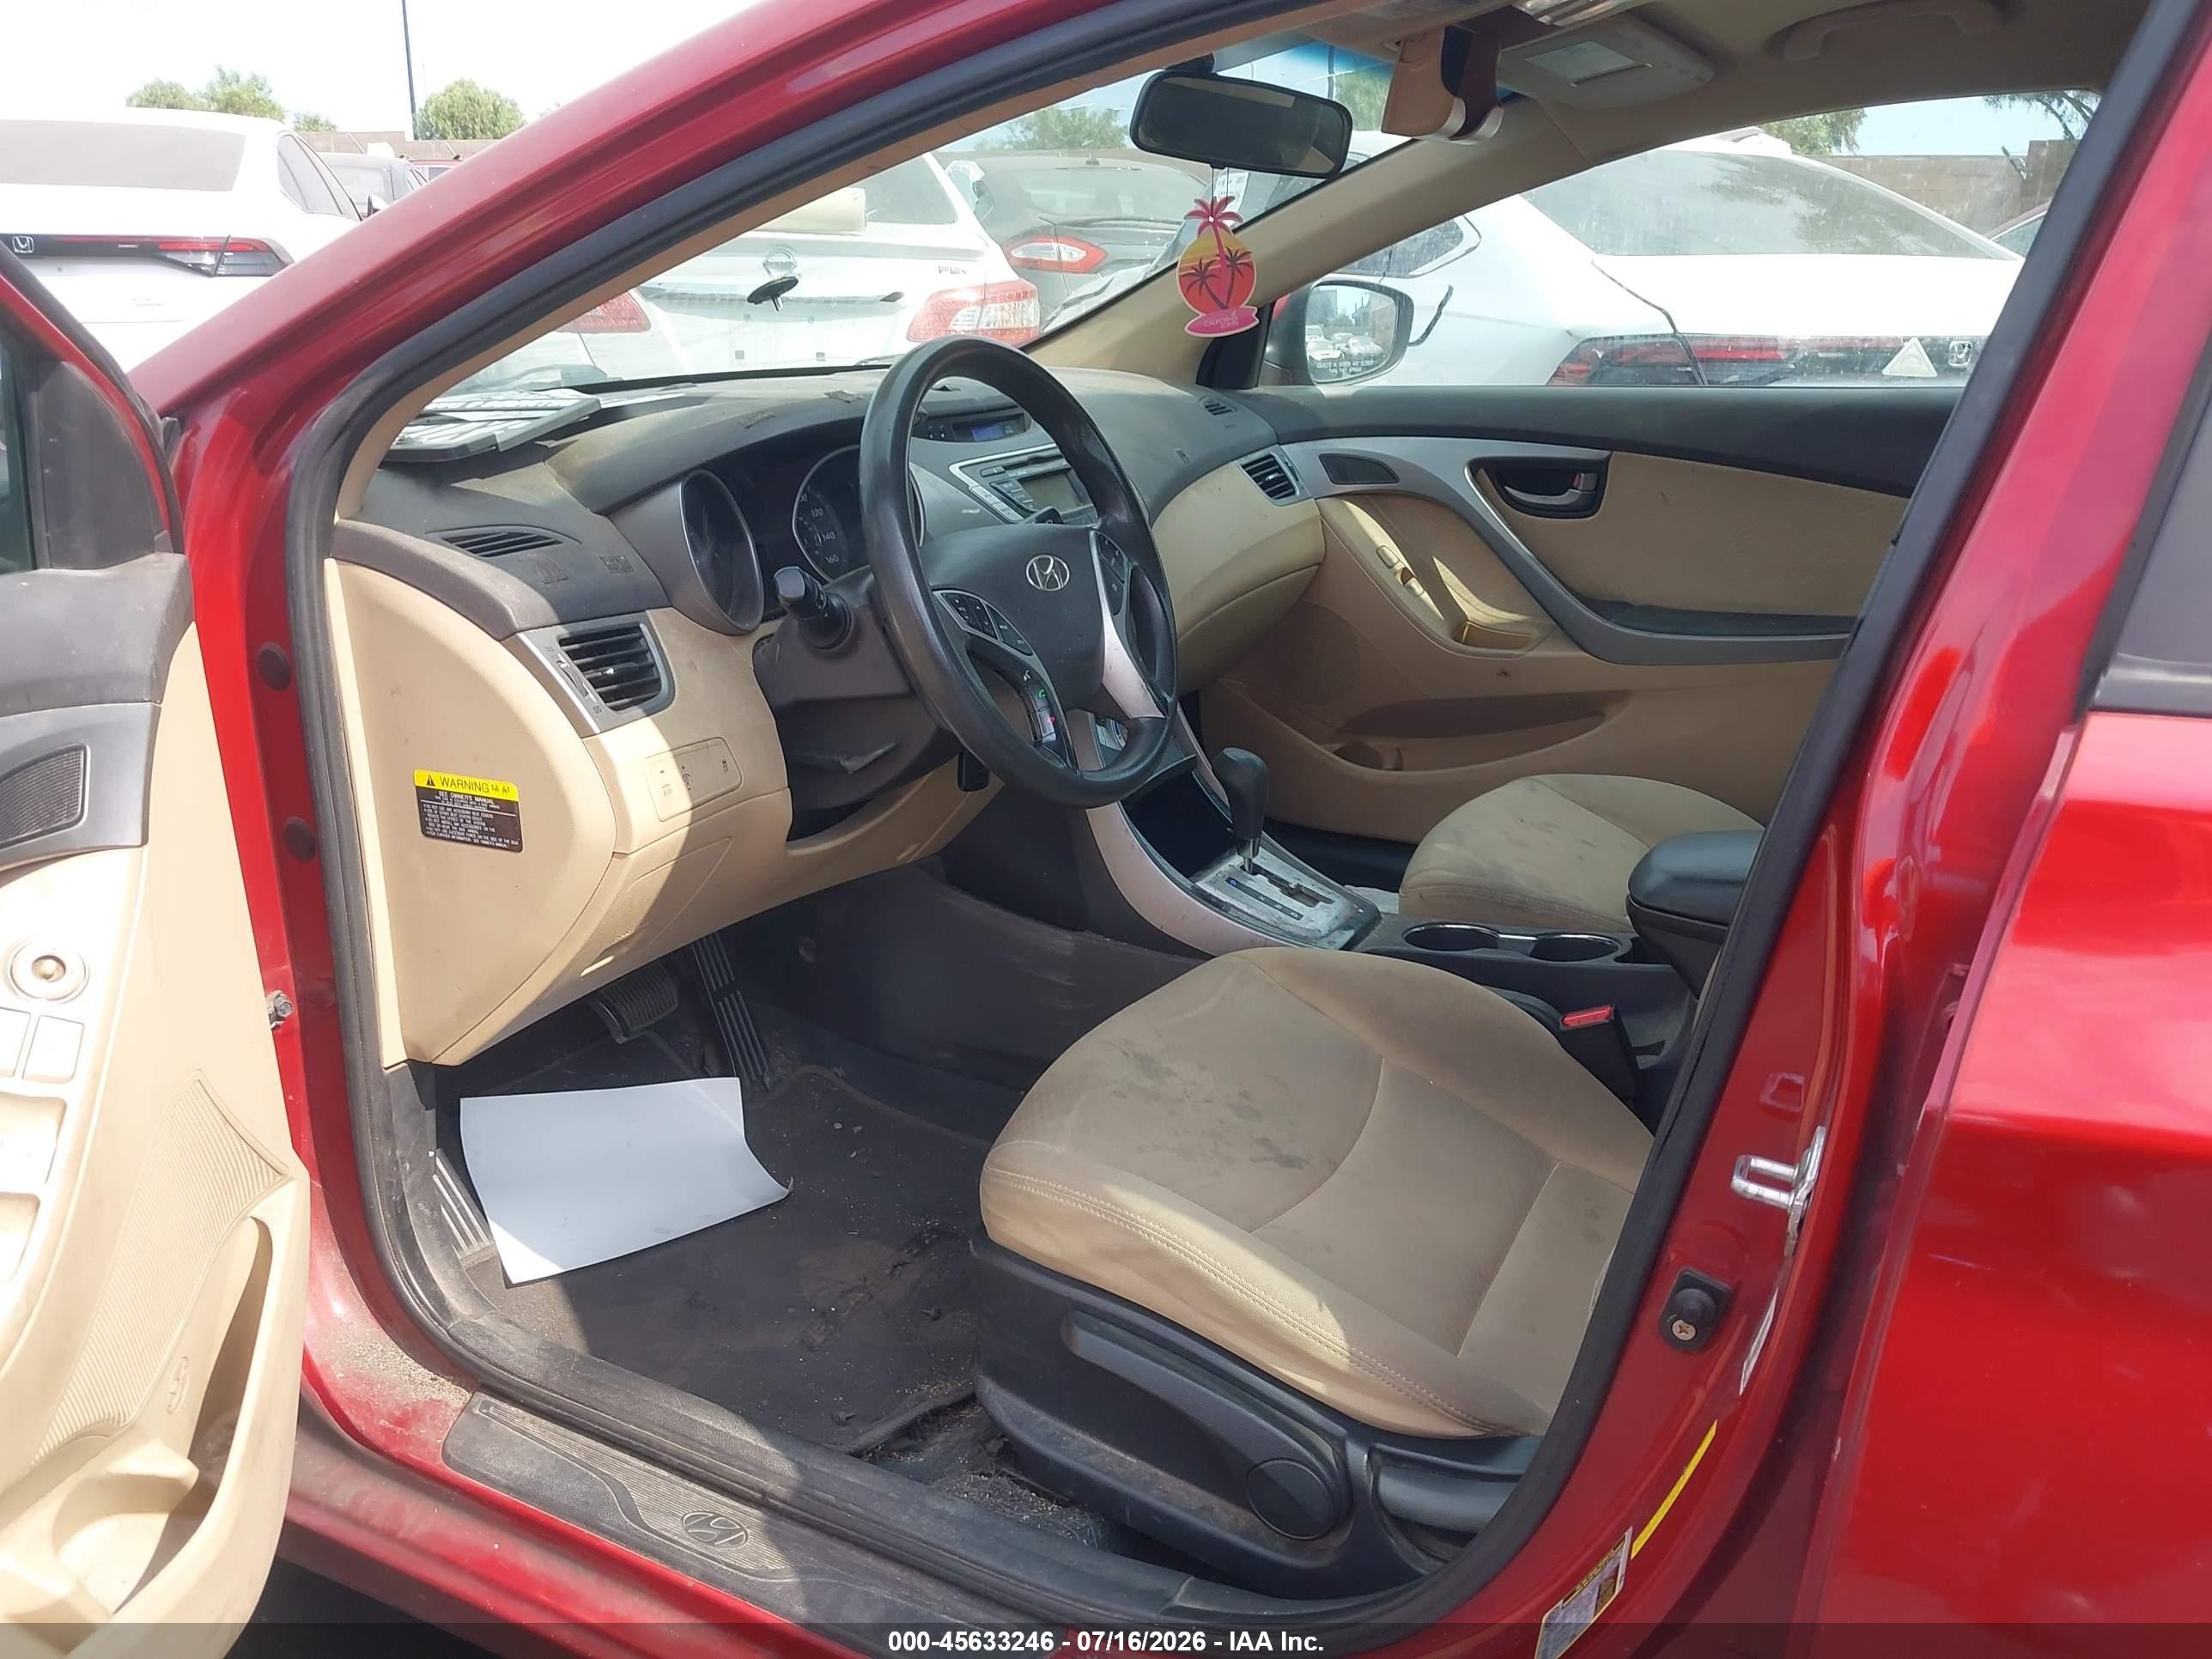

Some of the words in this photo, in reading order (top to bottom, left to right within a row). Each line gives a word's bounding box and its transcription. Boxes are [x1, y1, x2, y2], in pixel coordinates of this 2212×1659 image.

[811, 507, 823, 518] 120
[825, 554, 839, 564] 160
[439, 775, 489, 793] WARNING
